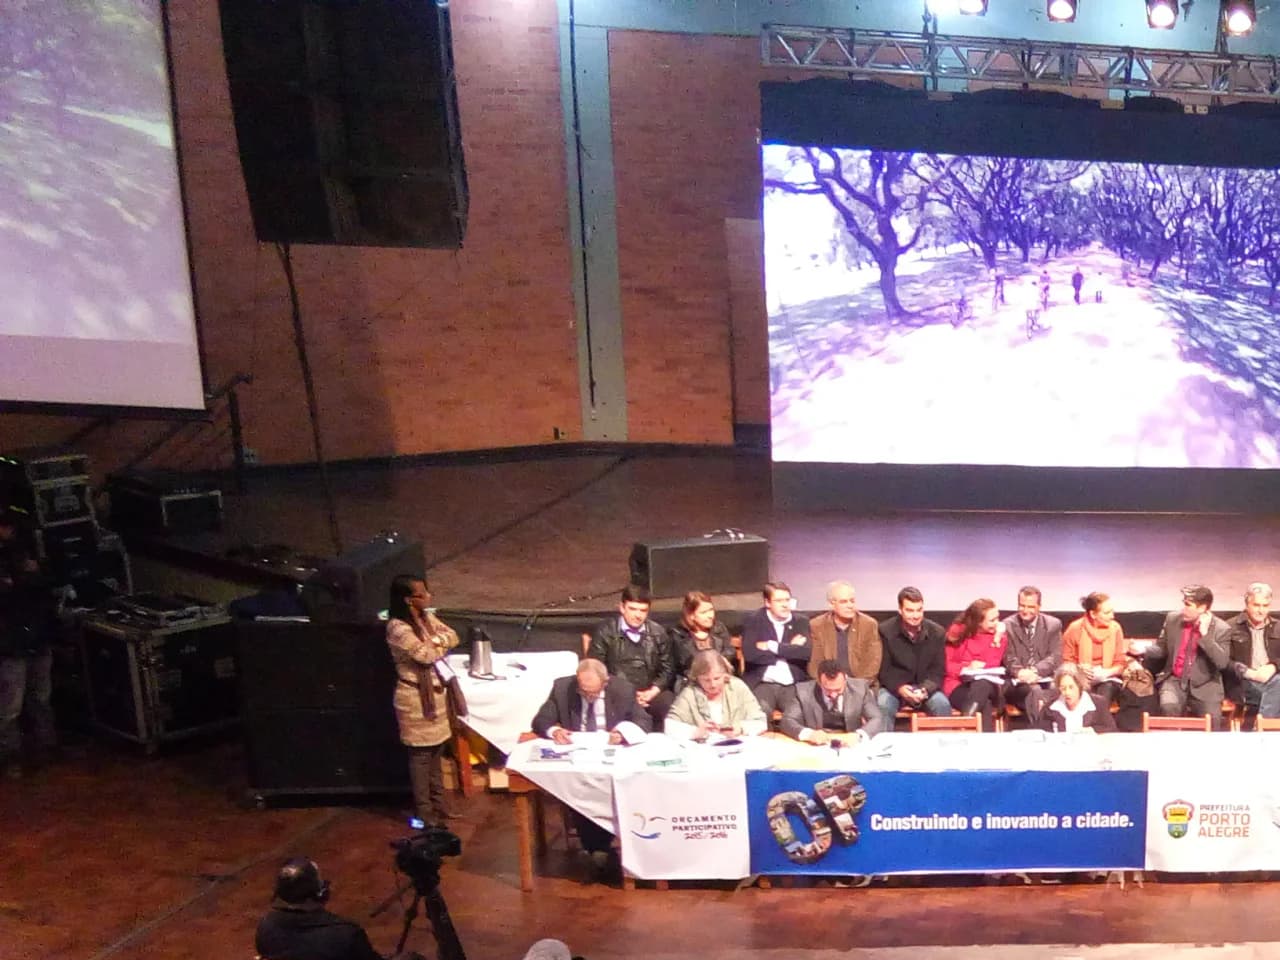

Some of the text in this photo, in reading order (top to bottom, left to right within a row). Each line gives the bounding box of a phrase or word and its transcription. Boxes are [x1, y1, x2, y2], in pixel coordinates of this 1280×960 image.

[870, 812, 1134, 831] Construindo e inovando a cidade.
[1199, 813, 1251, 826] PORTO
[672, 823, 737, 831] PARTICIPATIVO
[1197, 826, 1251, 838] ALEGRE
